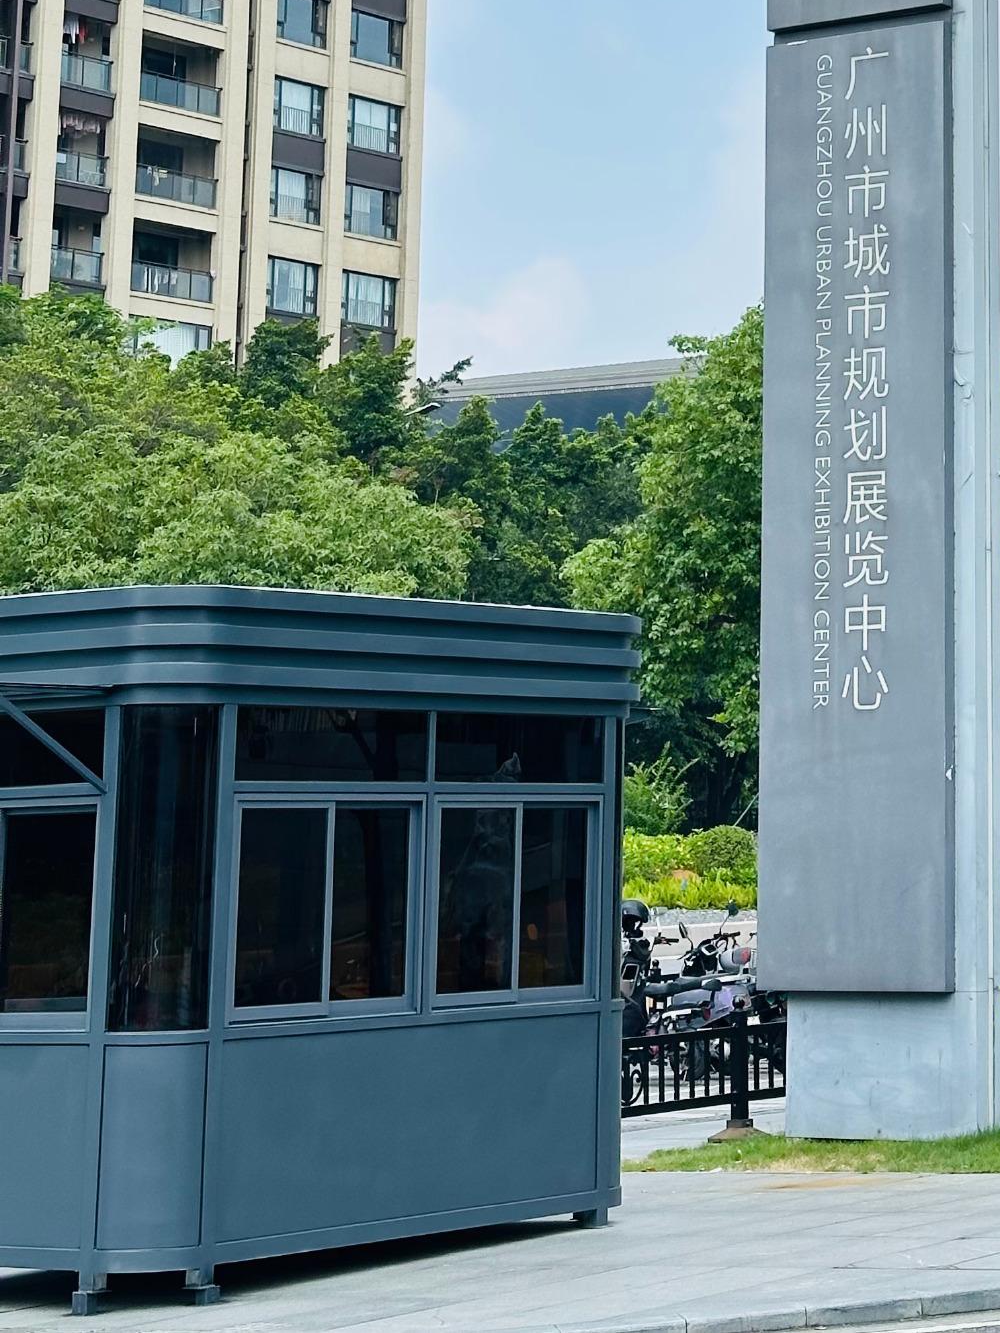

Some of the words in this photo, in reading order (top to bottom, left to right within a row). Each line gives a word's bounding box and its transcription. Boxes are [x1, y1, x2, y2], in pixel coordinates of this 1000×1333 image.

[815, 54, 833, 217] GUANGZHOU
[815, 225, 833, 310] URBAN
[814, 318, 833, 448] PLANNING
[841, 47, 891, 710] 广州市城市规划展览中心
[813, 456, 831, 600] EXHIBITION
[812, 610, 830, 709] CENTER
